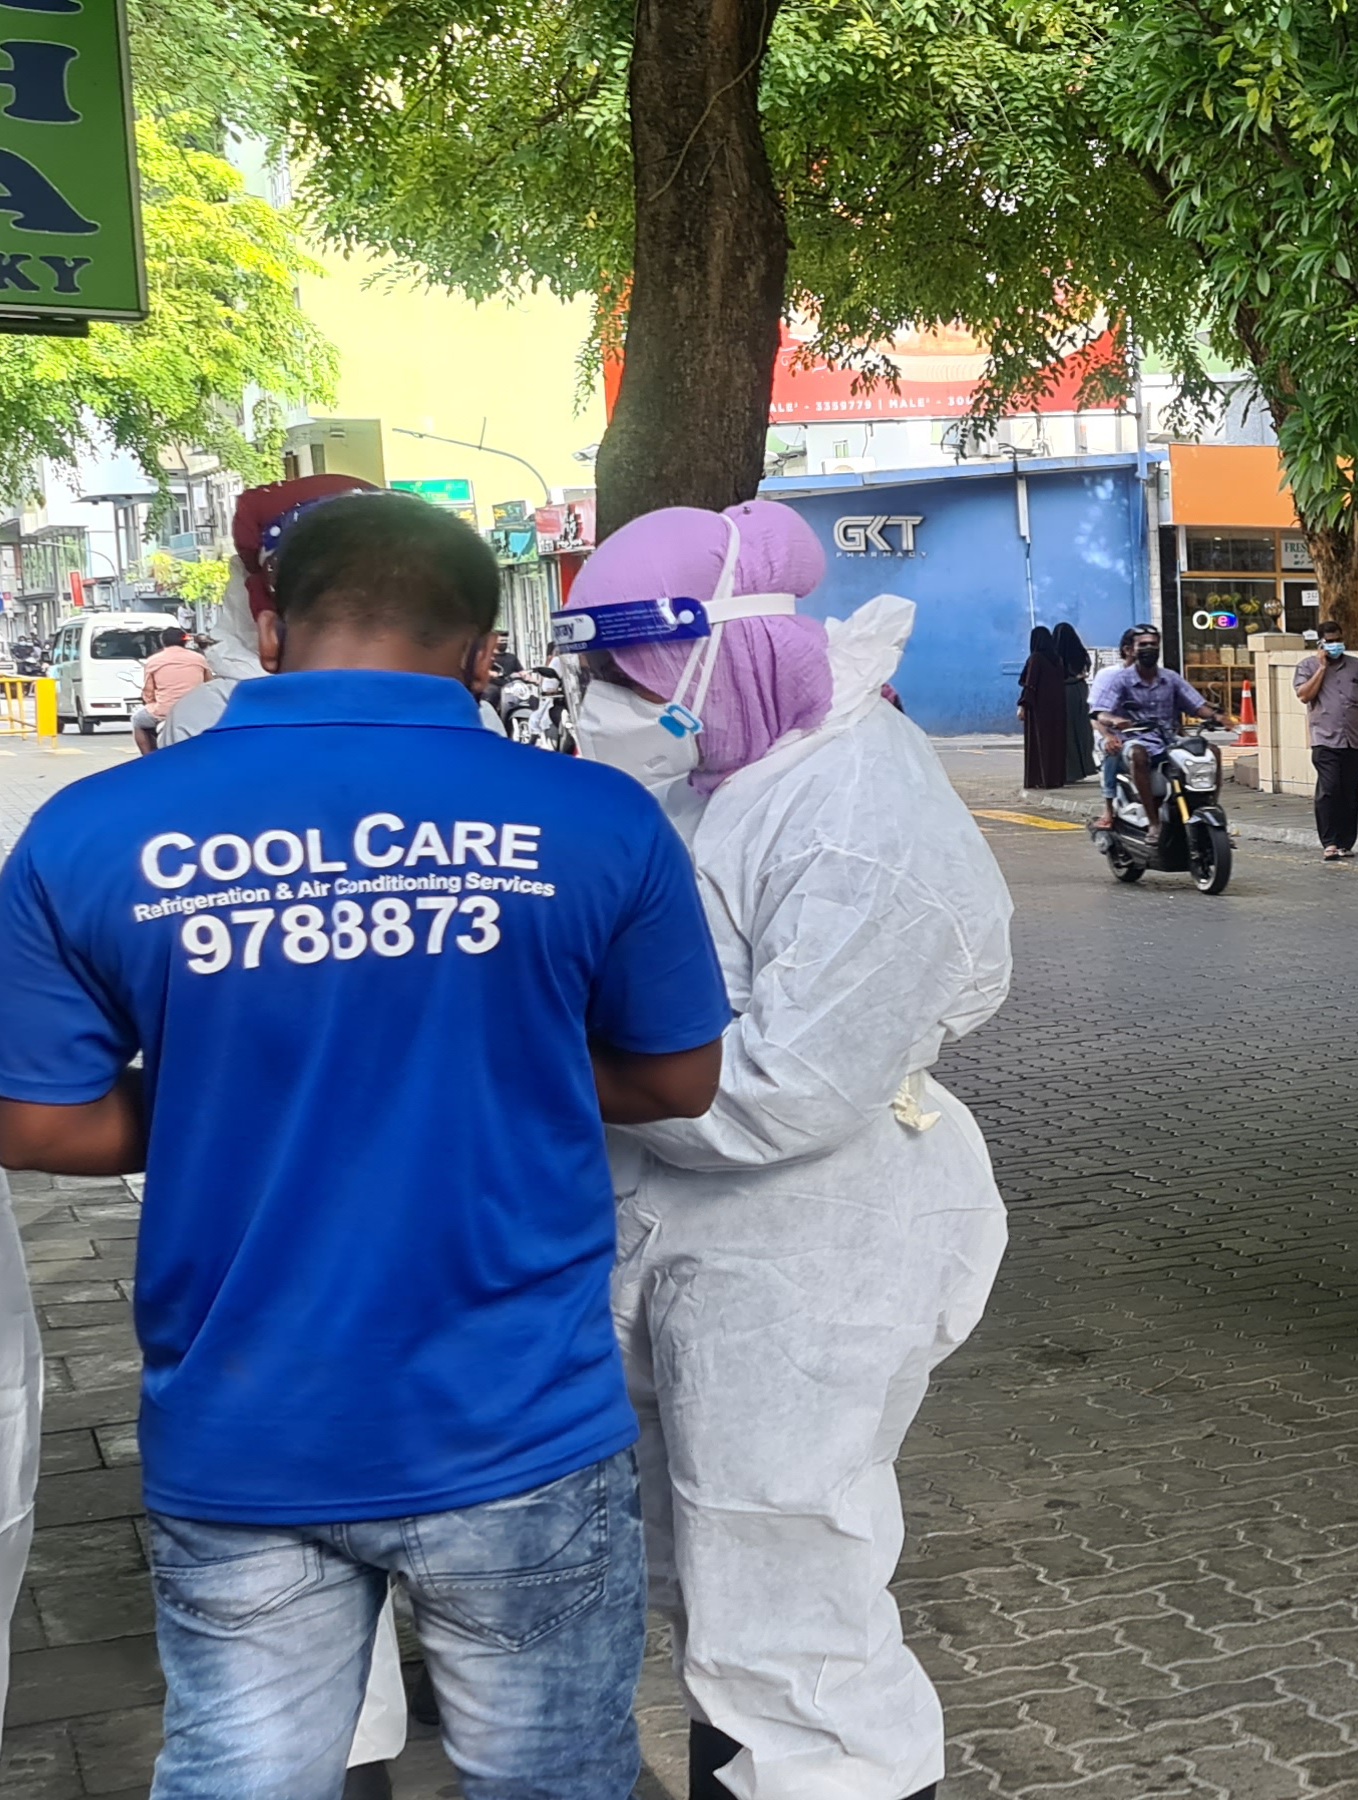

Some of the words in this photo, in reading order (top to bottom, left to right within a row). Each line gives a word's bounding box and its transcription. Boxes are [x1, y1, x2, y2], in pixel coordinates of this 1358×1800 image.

[833, 516, 924, 551] GKT
[1284, 542, 1307, 553] FRES
[140, 828, 347, 889] COOL
[353, 812, 541, 870] CARE
[133, 886, 270, 923] Refrigeration
[275, 882, 294, 900] &
[297, 879, 331, 899] Air
[334, 873, 462, 896] Conditioning
[465, 871, 556, 897] Services
[181, 895, 501, 974] 9788873
